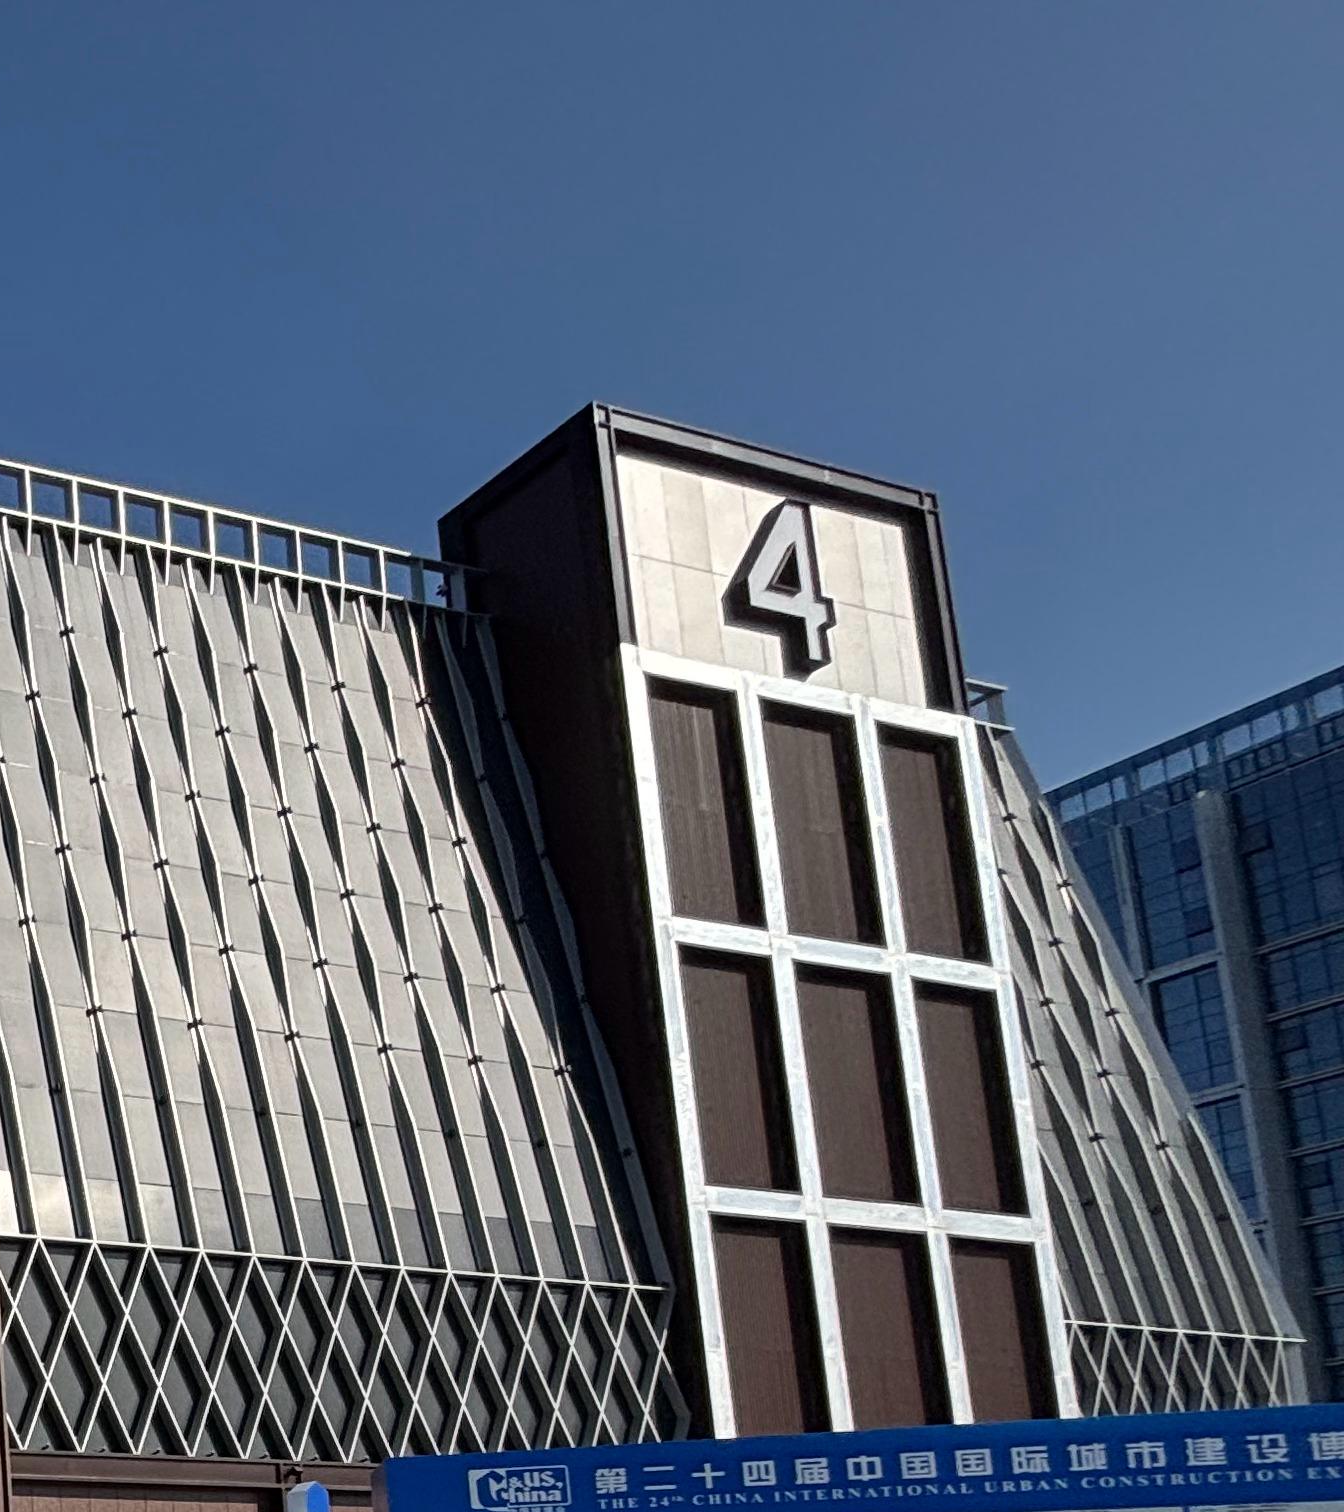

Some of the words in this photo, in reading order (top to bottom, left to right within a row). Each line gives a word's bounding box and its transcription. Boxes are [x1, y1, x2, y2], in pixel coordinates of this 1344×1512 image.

[723, 498, 836, 681] 4
[597, 1498, 640, 1511] THE
[694, 1492, 764, 1506] CHINA
[774, 1482, 974, 1503] INTERNATIONAL
[984, 1476, 1069, 1494] URBAN
[1080, 1469, 1293, 1490] CONSTRUCTION
